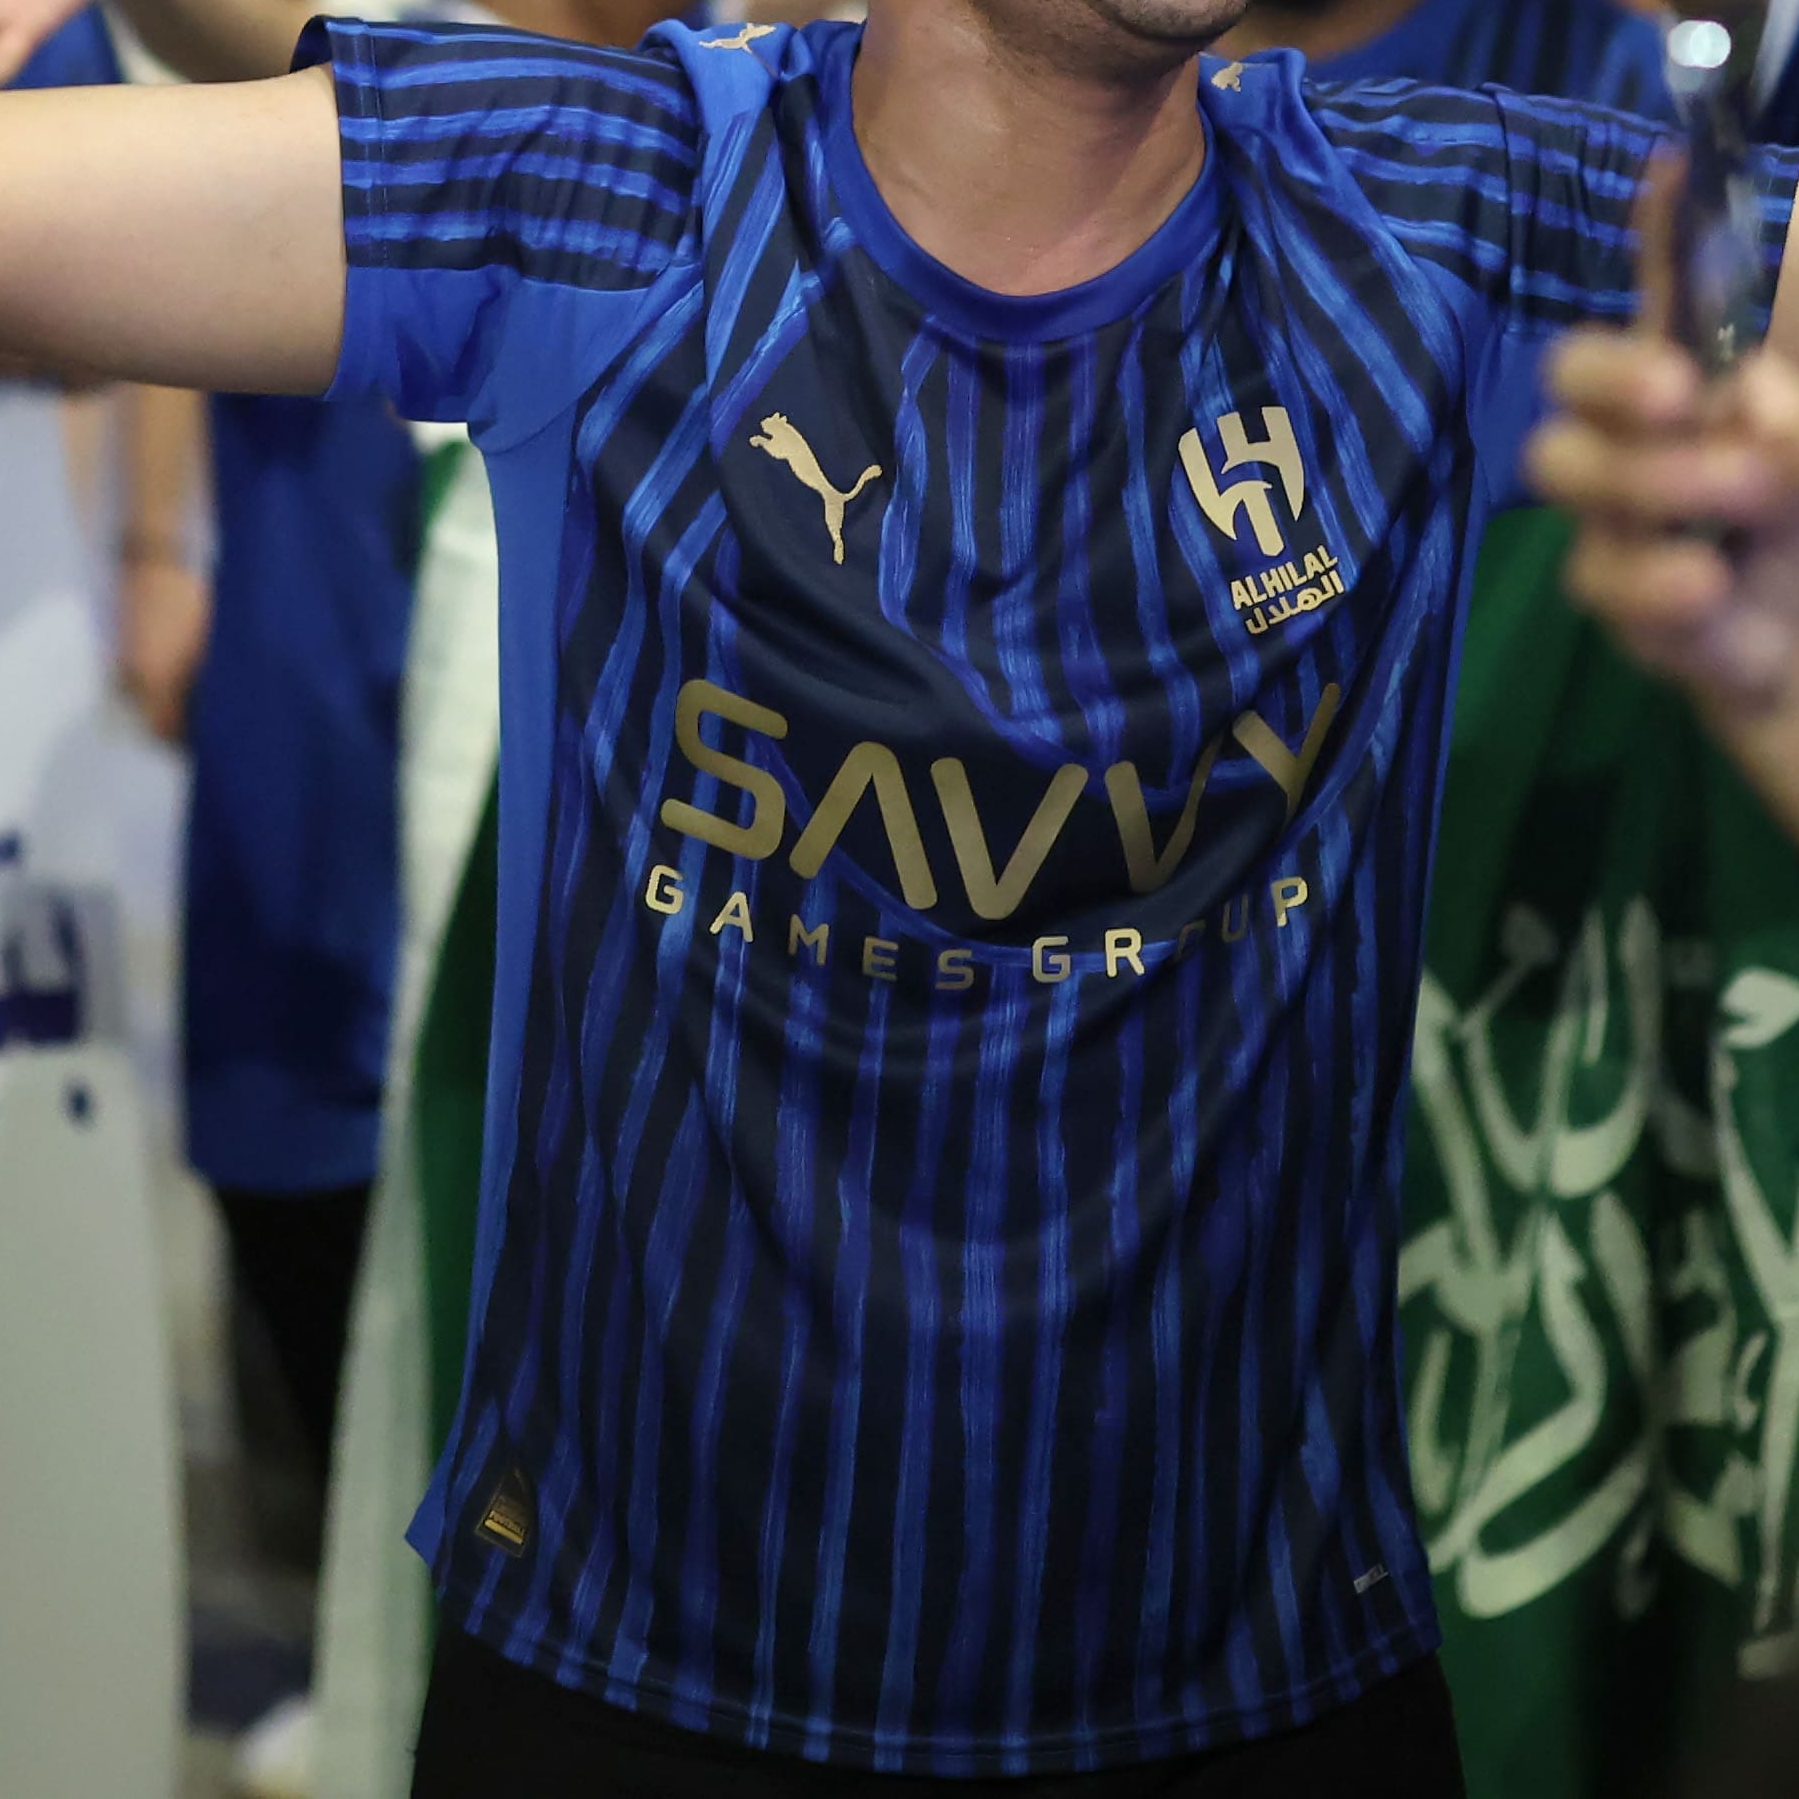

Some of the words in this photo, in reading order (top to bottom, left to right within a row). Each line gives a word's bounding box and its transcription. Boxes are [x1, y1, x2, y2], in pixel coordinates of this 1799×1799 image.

[1230, 544, 1339, 611] ALHILAL
[1245, 569, 1346, 635] الهلال
[660, 678, 1342, 920] SAVVY
[645, 864, 975, 992] GAMES
